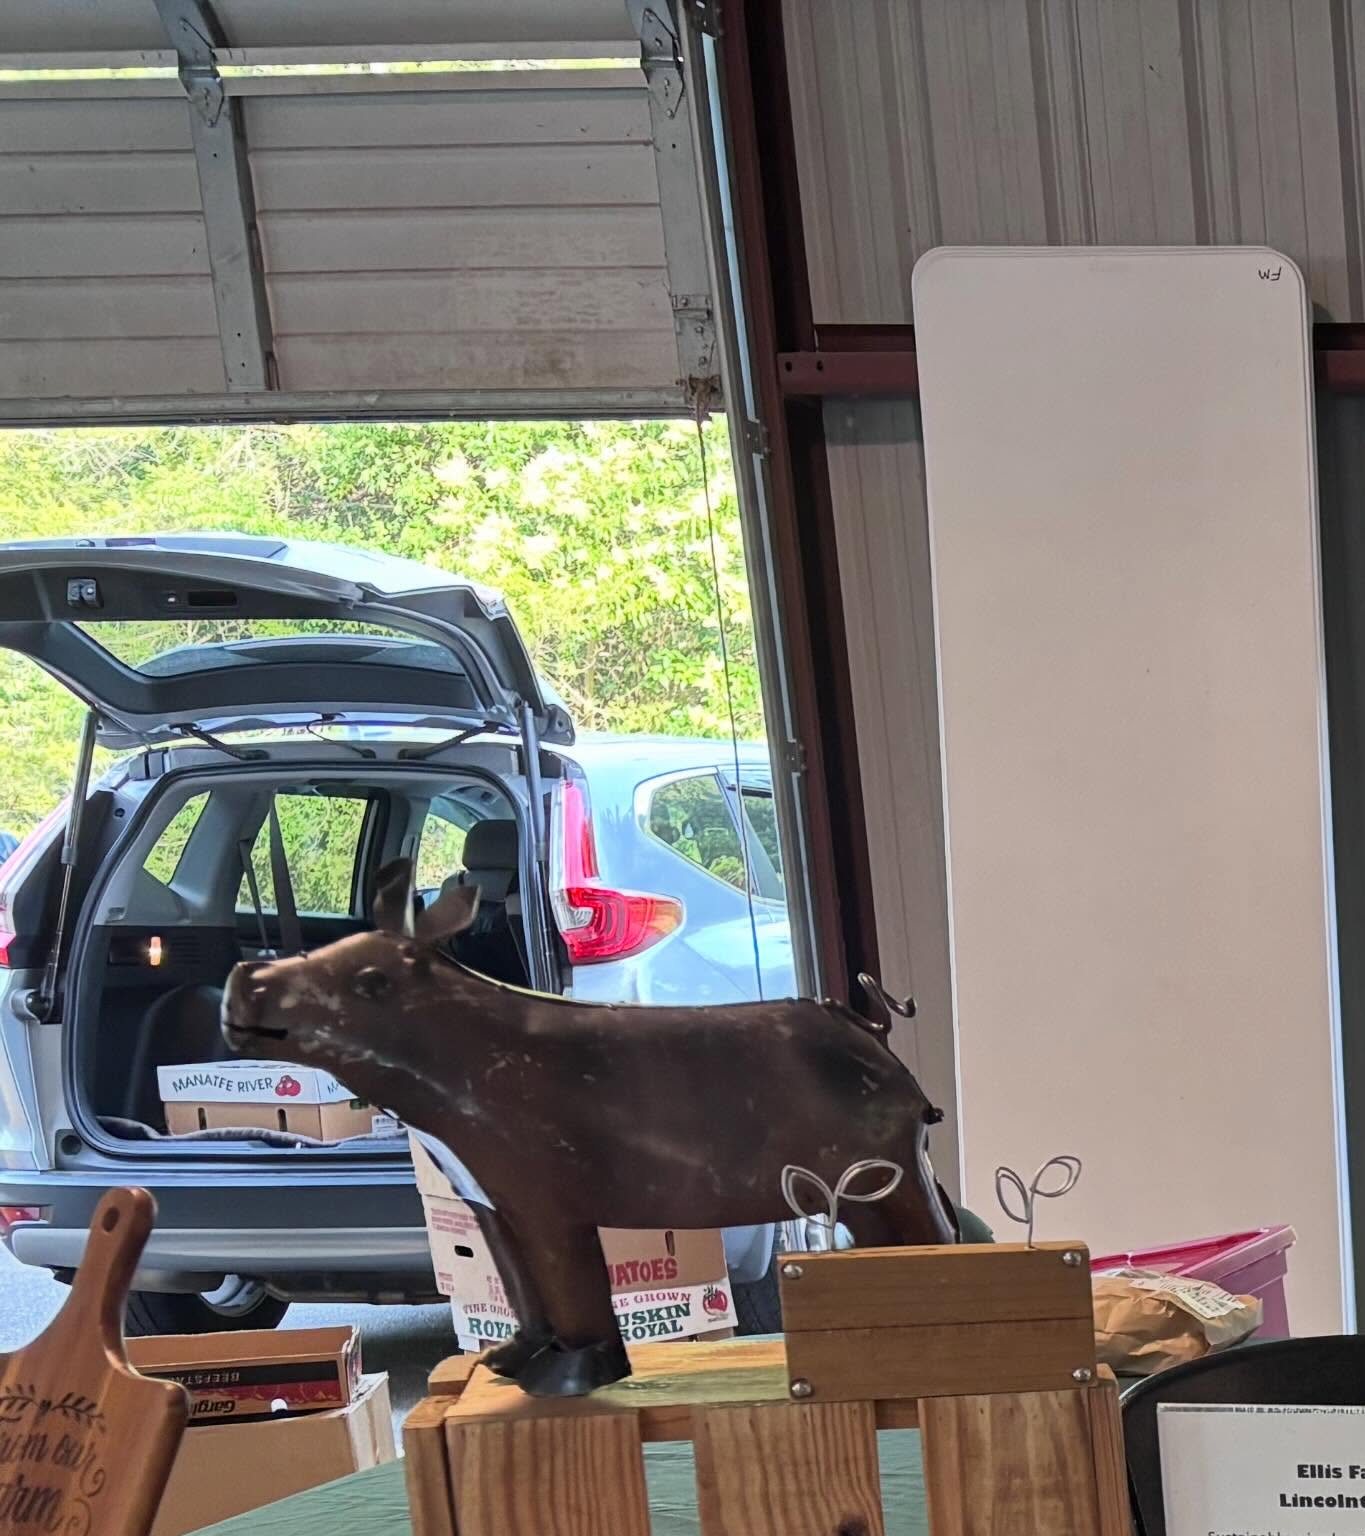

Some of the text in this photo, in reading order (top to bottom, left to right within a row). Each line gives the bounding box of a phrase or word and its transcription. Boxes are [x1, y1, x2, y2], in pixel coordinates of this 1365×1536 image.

[237, 1077, 274, 1093] RIVER
[634, 1291, 693, 1305] GROWN
[1297, 1463, 1343, 1479] Ellis
